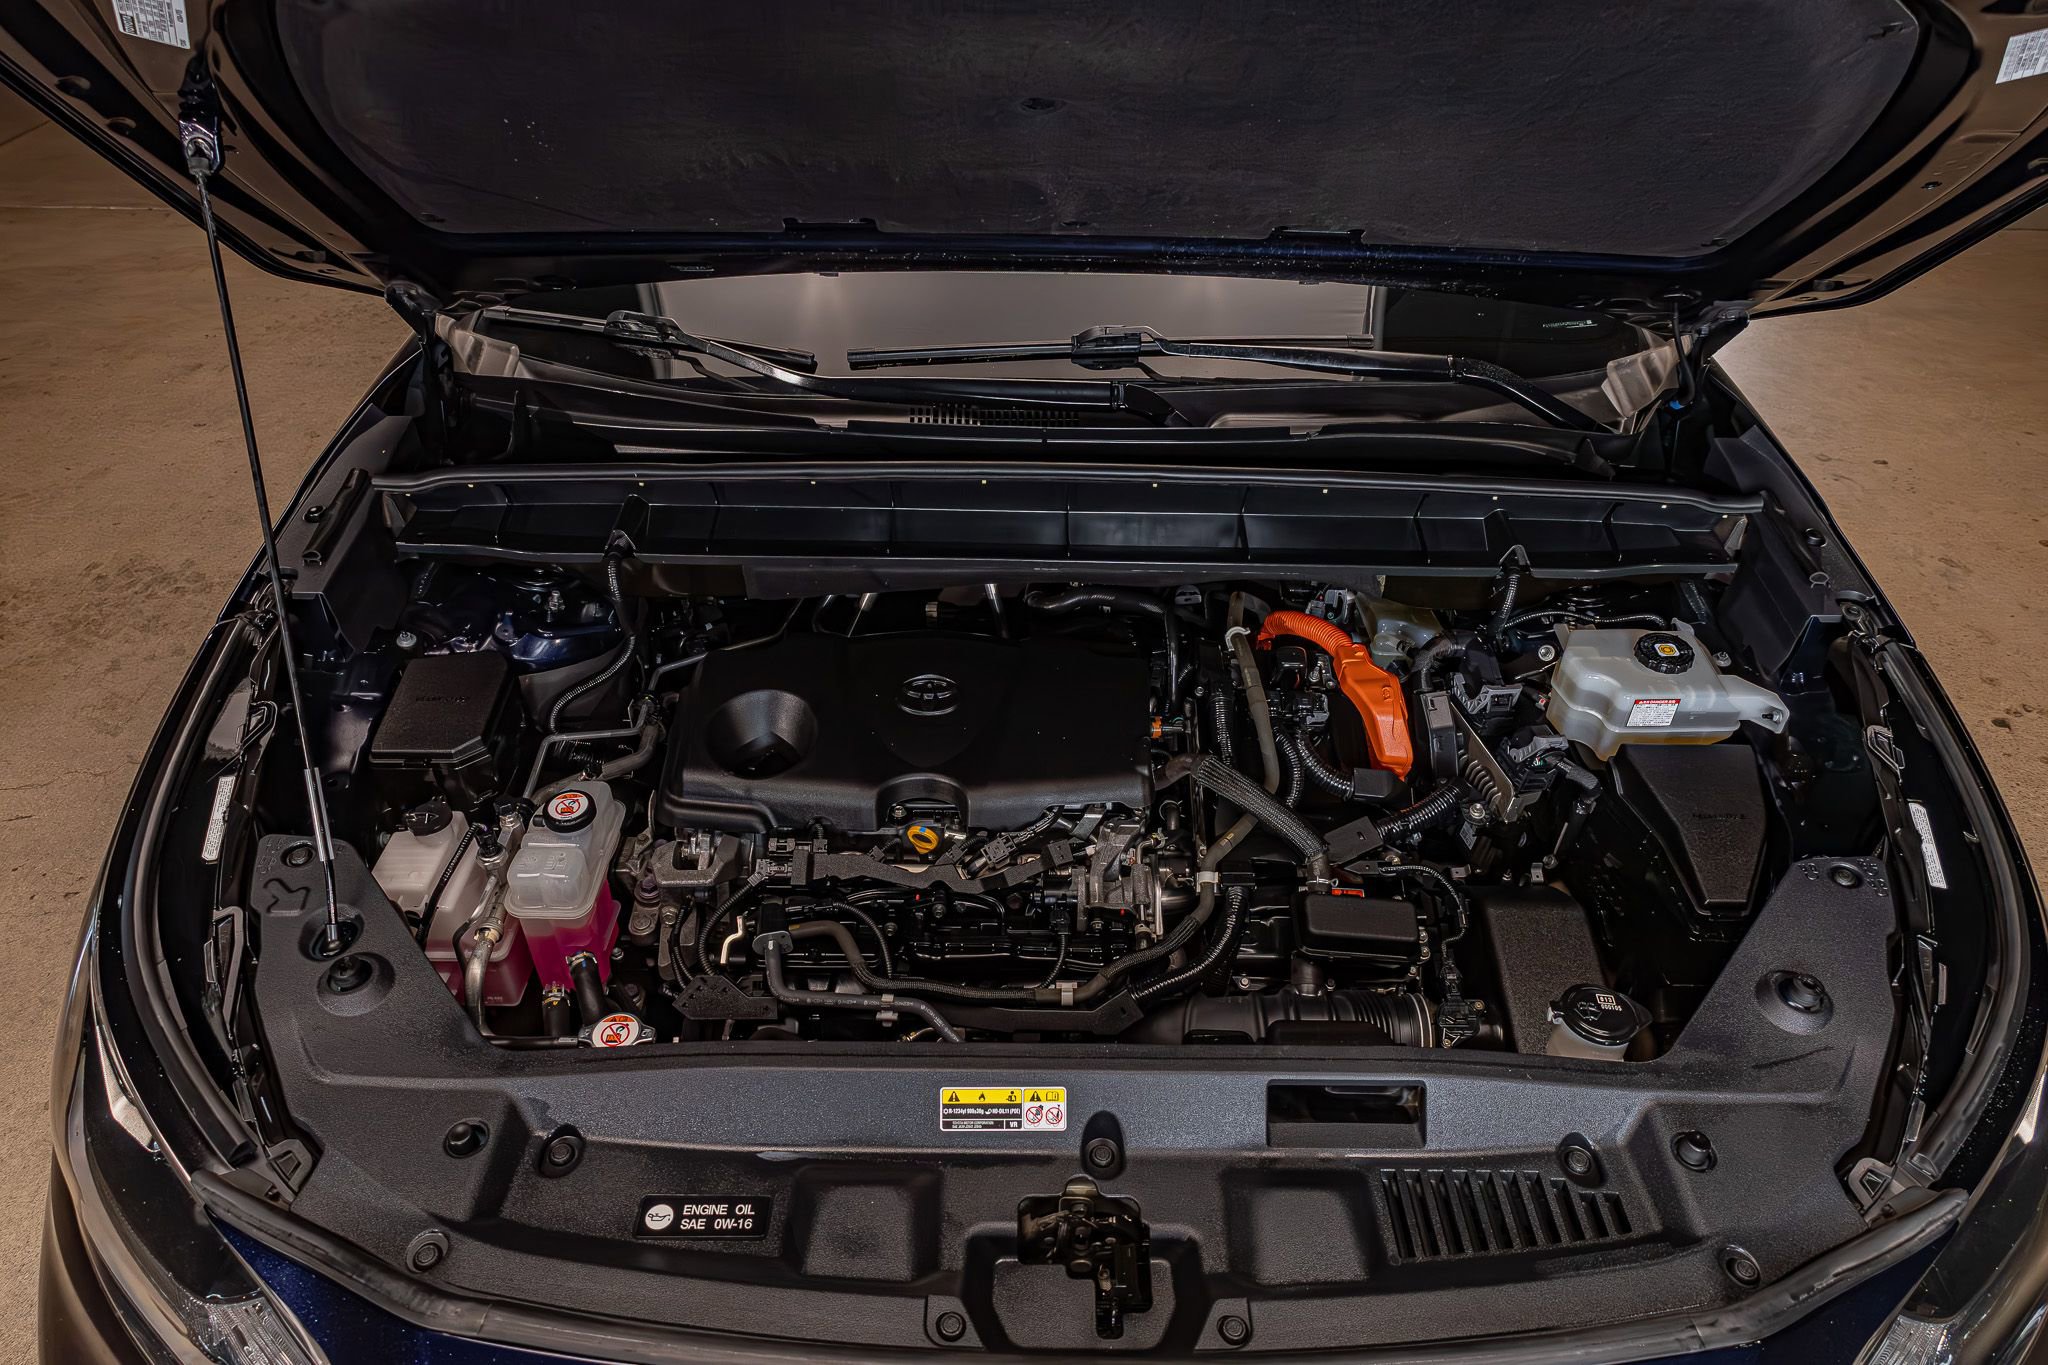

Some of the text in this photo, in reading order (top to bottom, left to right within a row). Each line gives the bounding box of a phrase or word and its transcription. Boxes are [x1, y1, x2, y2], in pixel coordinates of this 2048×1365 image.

[683, 1204, 755, 1215] ENGINE OIL
[680, 1218, 753, 1230] SAE 0W-16
